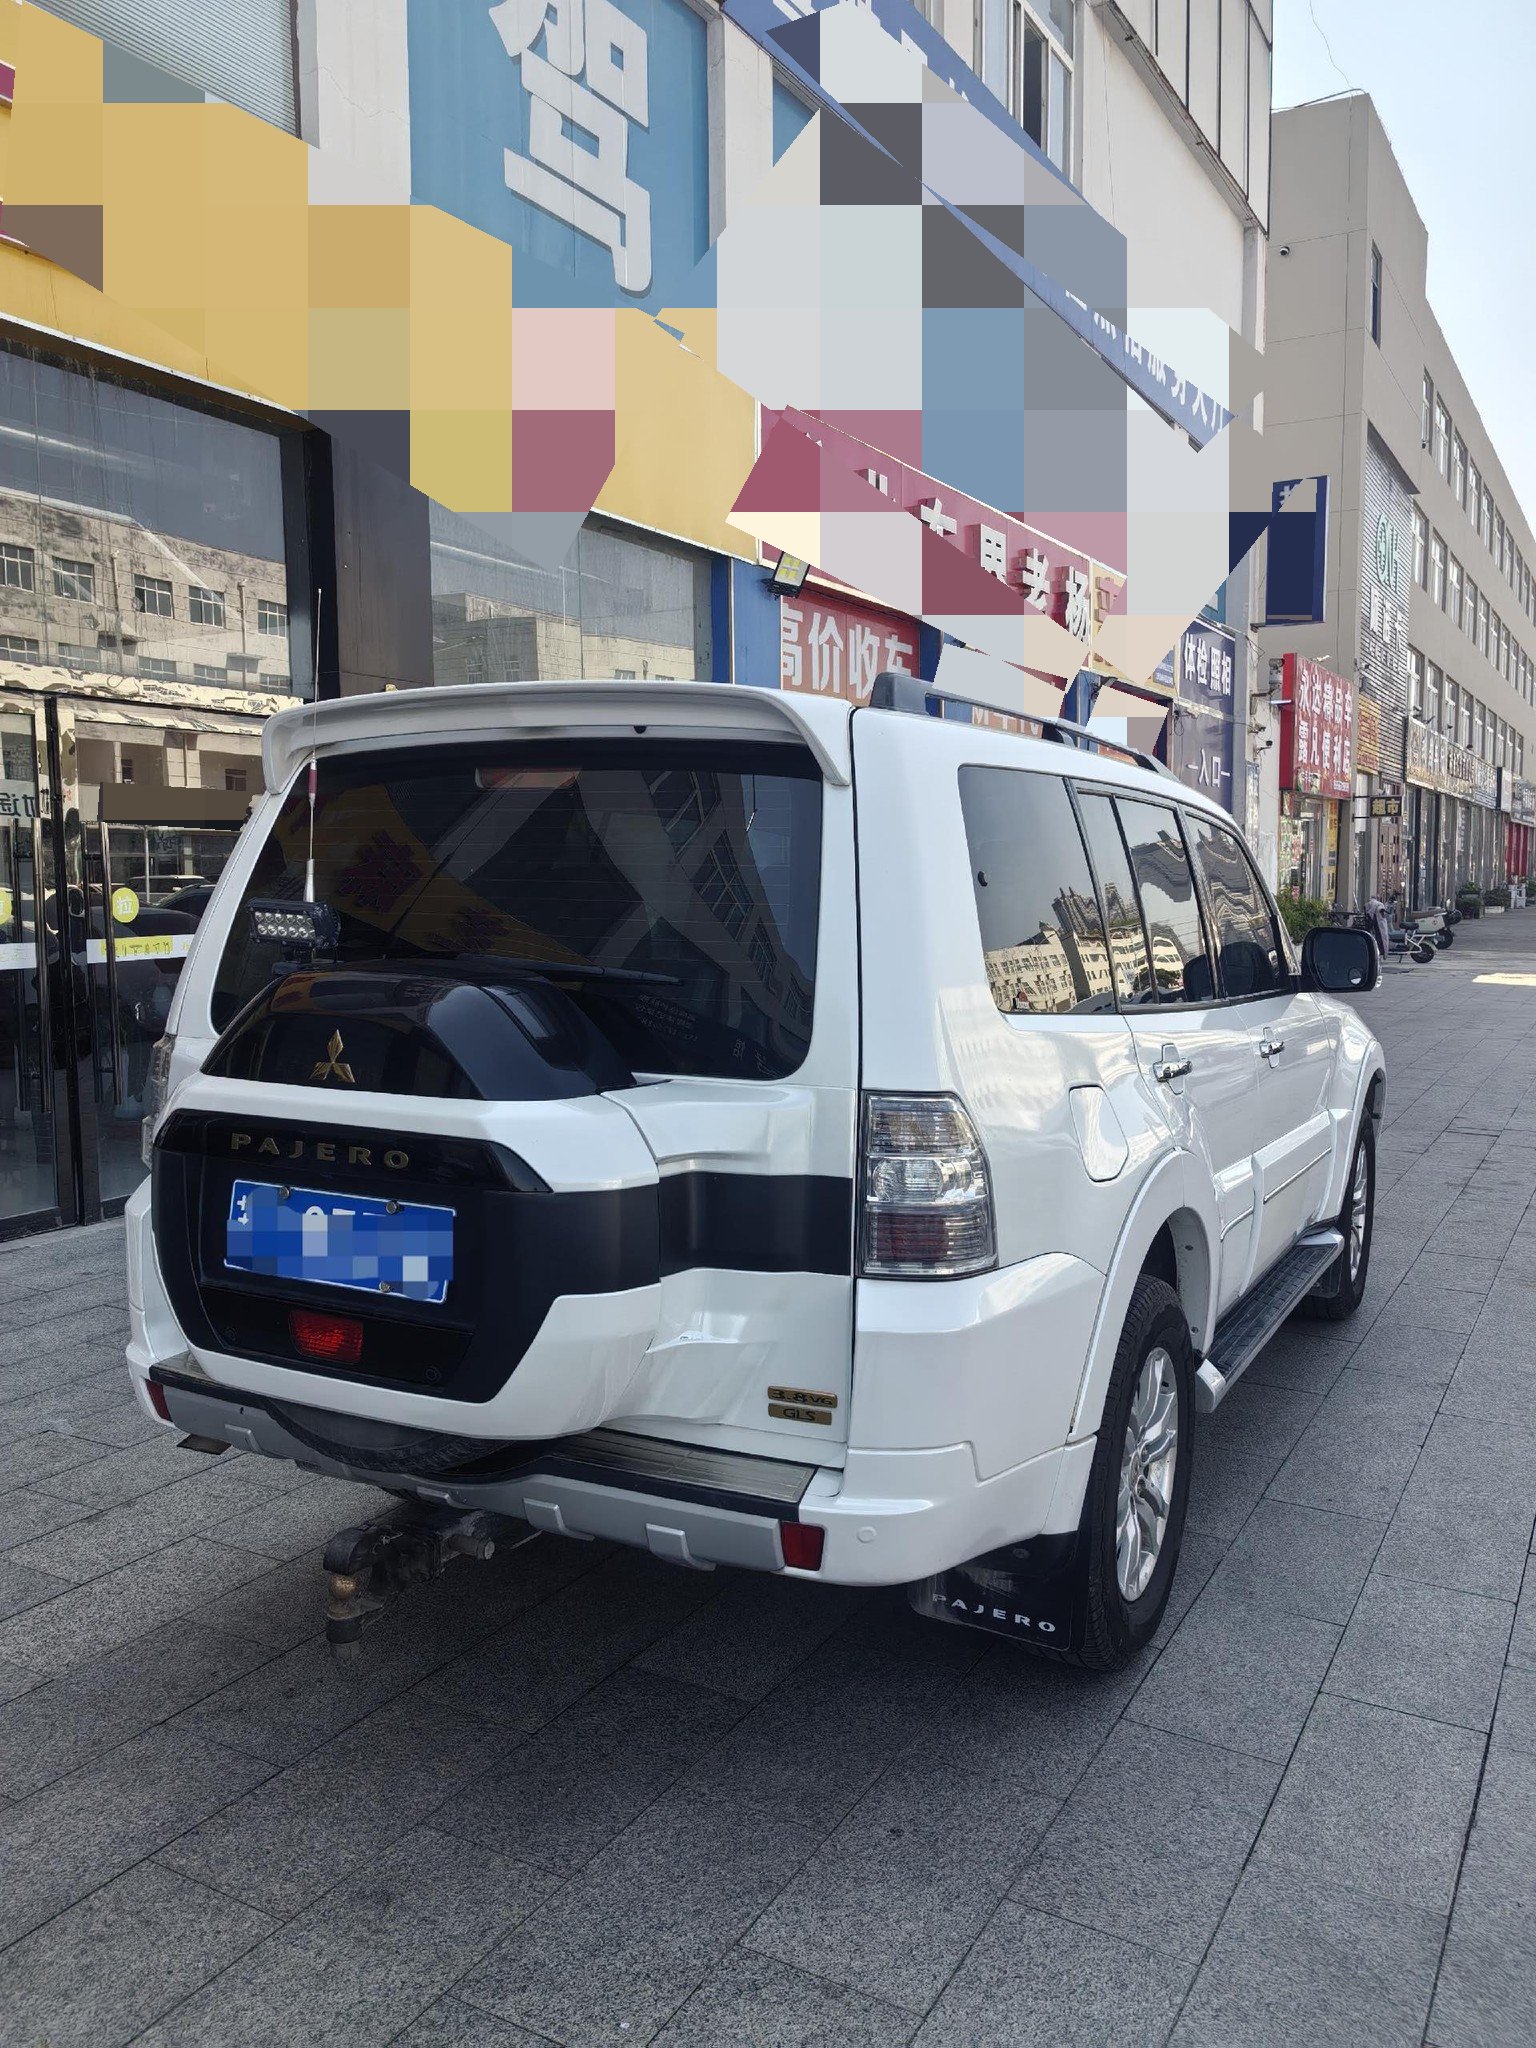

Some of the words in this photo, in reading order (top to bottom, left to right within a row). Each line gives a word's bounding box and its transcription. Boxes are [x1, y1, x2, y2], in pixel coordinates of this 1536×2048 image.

[782, 602, 914, 700] 高价收车
[1184, 632, 1232, 696] 体检照相
[1299, 668, 1353, 729] 永达精品车
[1372, 798, 1400, 815] 超市
[230, 1132, 410, 1170] PAJERO
[783, 1408, 816, 1422] GLS
[932, 1593, 1056, 1633] PAJERO
